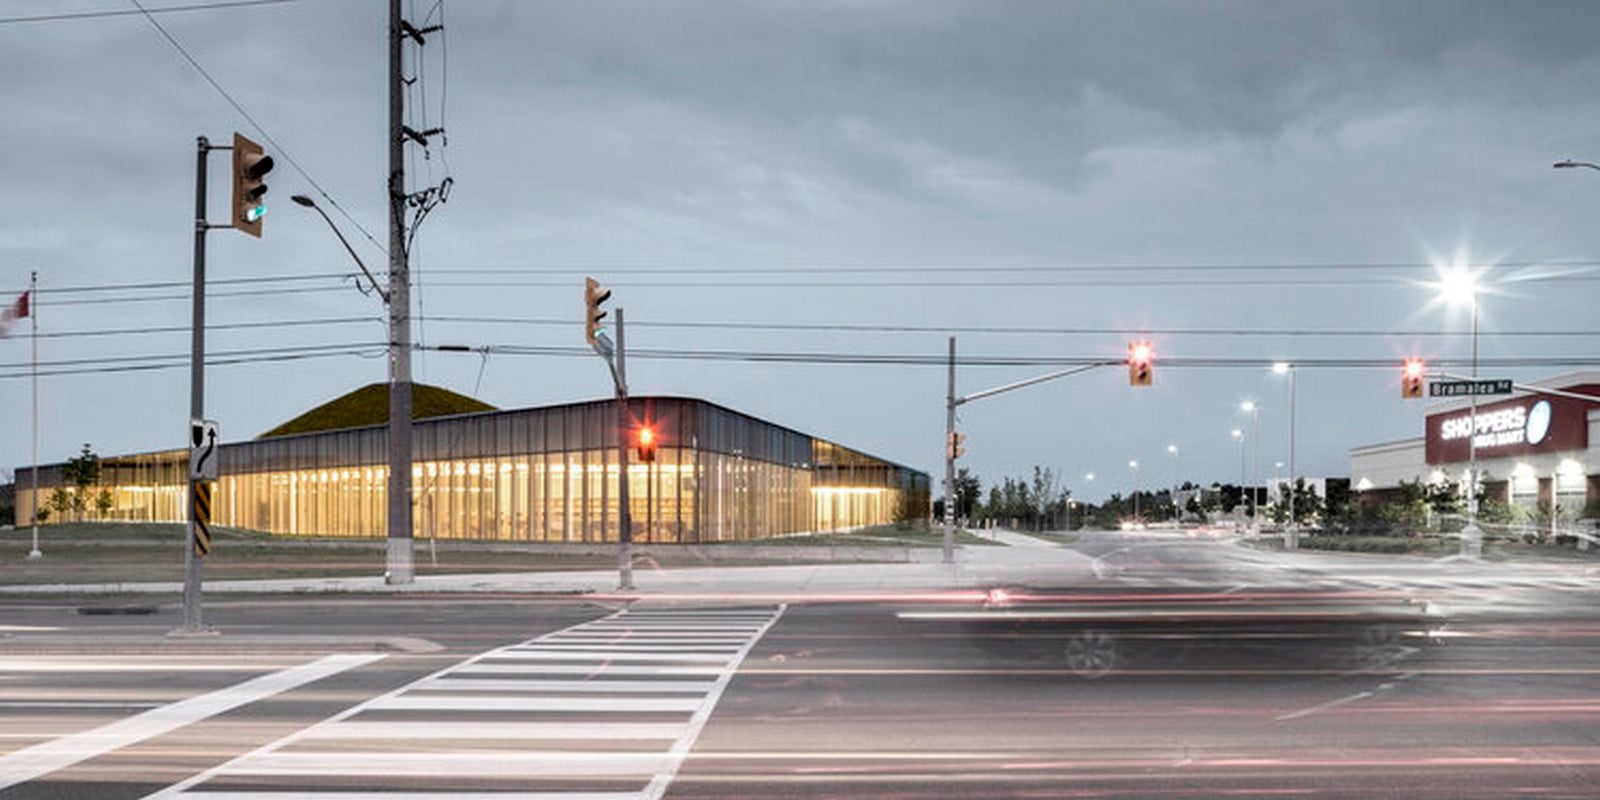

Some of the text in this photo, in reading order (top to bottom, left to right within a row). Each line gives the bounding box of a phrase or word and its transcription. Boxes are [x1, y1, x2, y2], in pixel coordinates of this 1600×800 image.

[1433, 382, 1495, 395] Bramalea
[1441, 406, 1526, 440] SHOPPERS
[1497, 429, 1525, 445] MART
